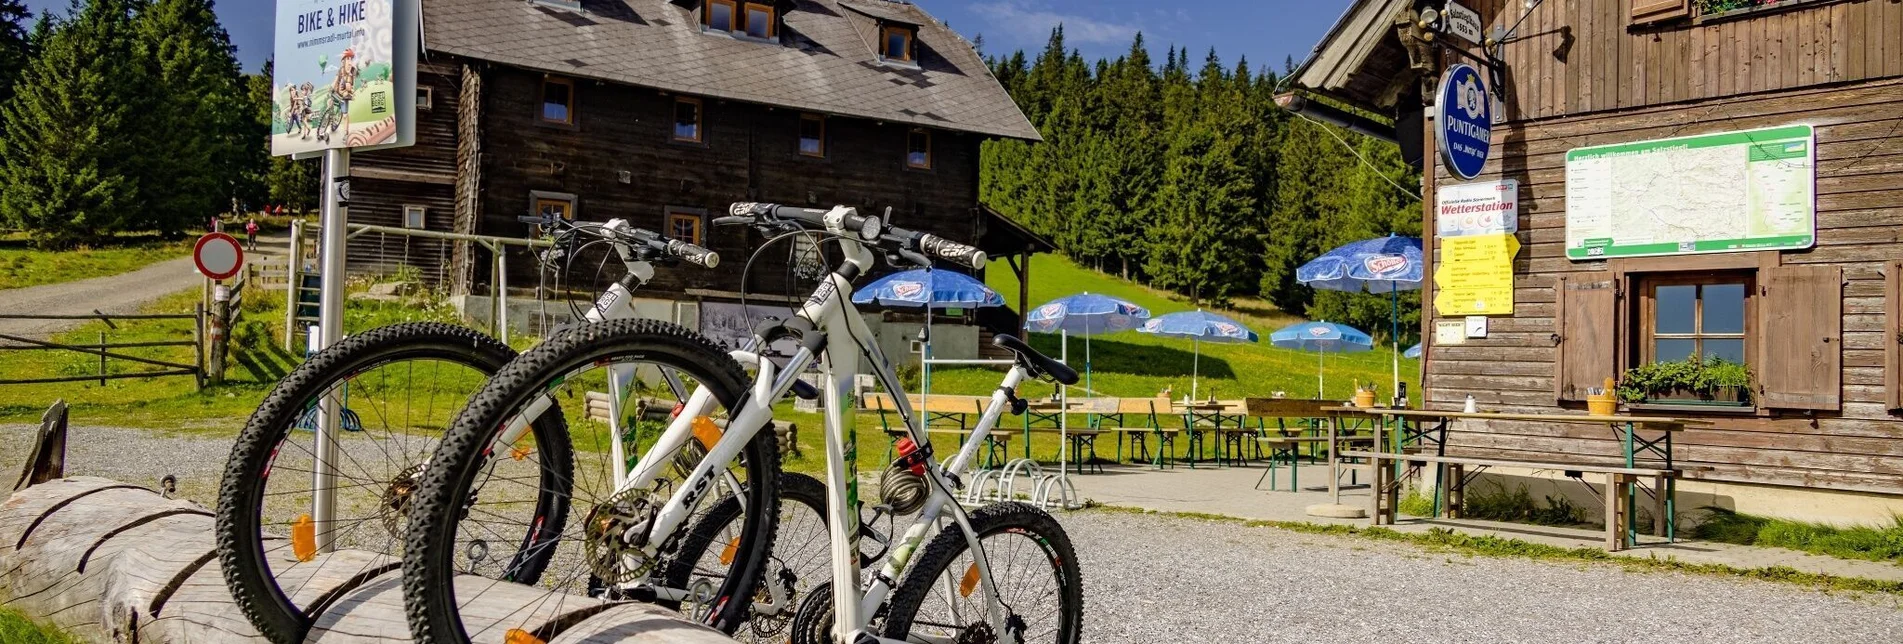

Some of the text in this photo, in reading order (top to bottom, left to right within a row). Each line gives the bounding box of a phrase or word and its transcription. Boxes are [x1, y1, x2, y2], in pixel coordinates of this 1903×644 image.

[298, 0, 365, 34] BIKE & HIKE
[1447, 114, 1491, 144] PUNTIGAMER
[1453, 142, 1463, 152] DAS
[1600, 149, 1639, 159] willkommen
[1441, 201, 1514, 216] Wetterstation
[681, 464, 716, 511] RST
